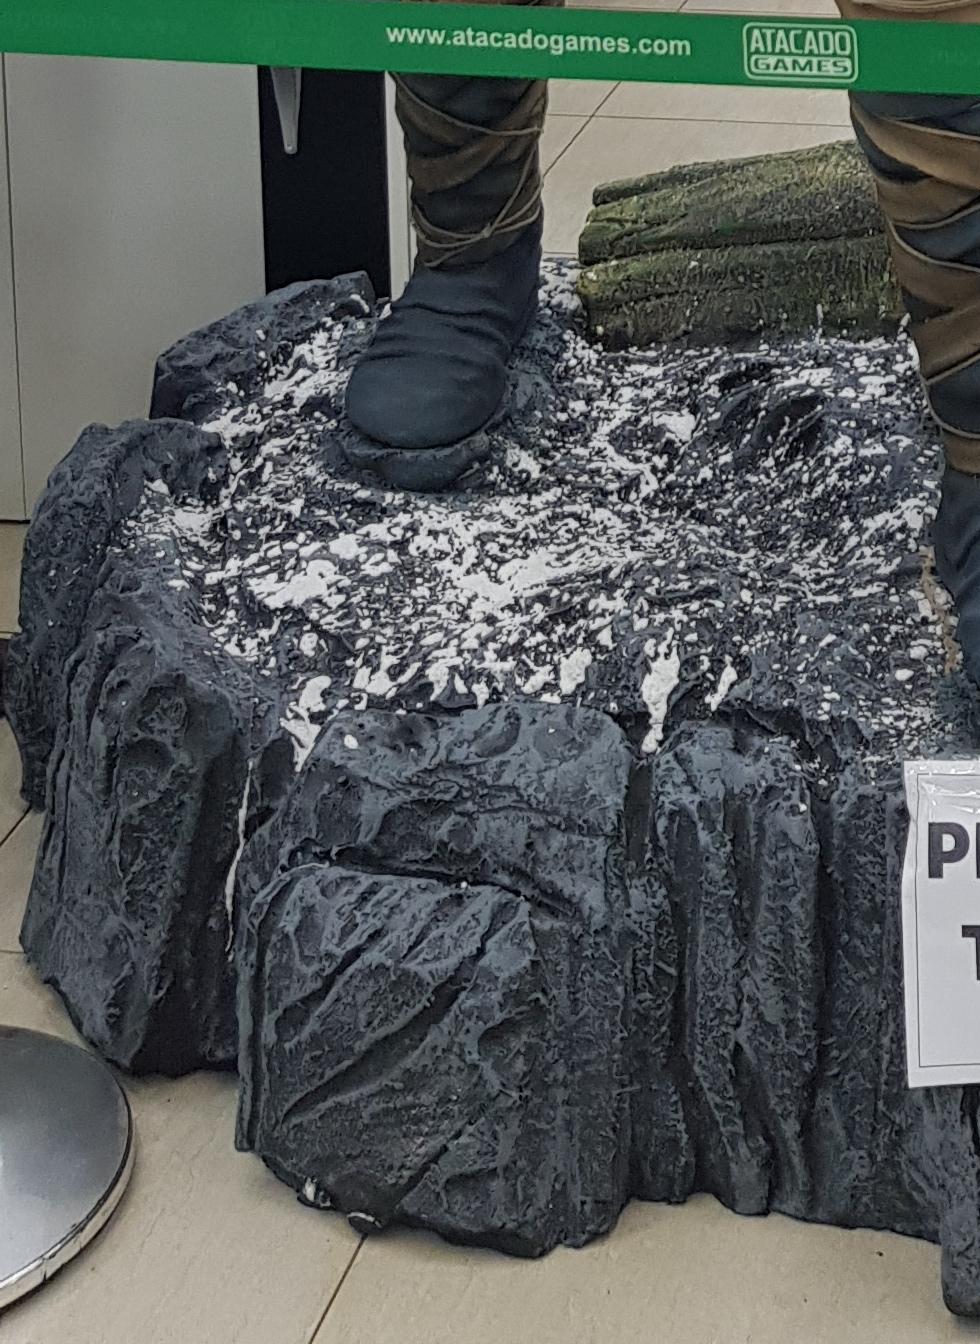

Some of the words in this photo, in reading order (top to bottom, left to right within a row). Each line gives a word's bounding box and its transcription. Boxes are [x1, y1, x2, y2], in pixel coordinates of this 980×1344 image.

[385, 25, 691, 56] www.atacadogames.com
[750, 28, 852, 55] ATACADO
[753, 57, 849, 73] GAMES
